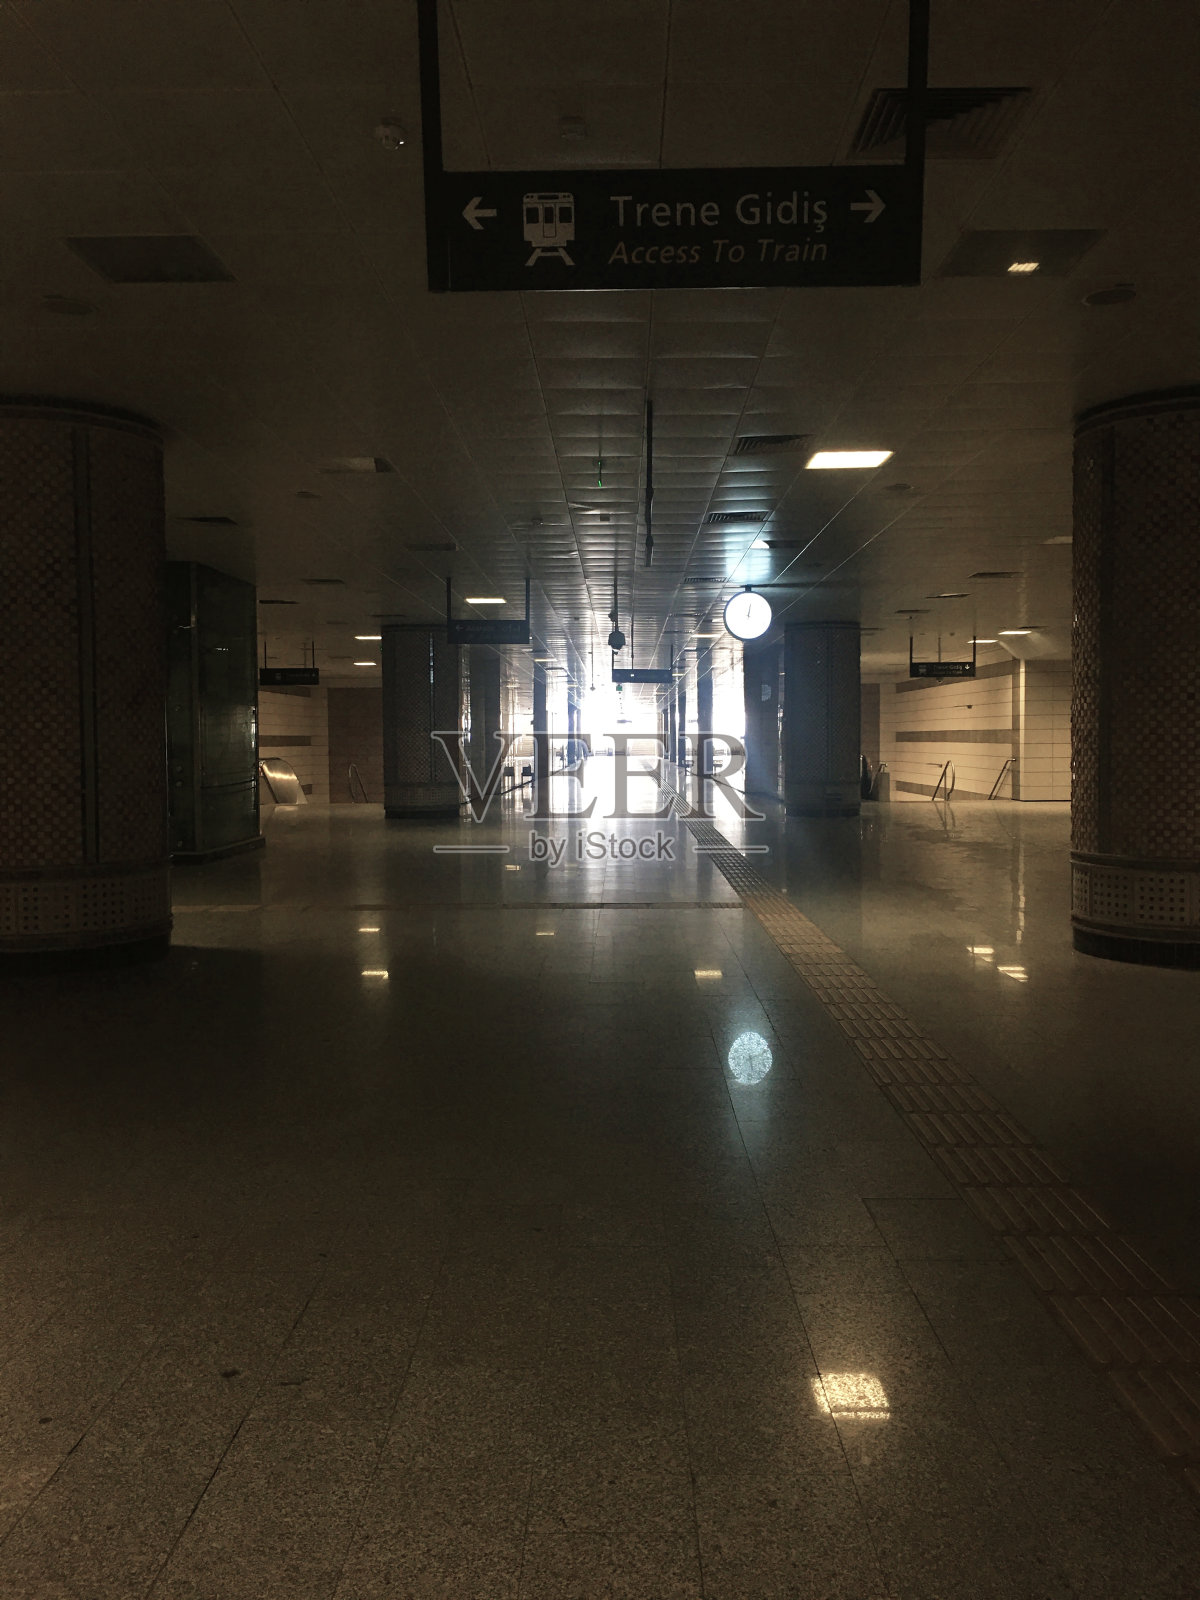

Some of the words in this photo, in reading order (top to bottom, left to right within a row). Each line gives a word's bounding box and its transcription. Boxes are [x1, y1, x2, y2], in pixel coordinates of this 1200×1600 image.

[609, 195, 721, 227] Trene
[735, 190, 829, 233] Gidiş
[607, 240, 702, 265] Access
[712, 239, 745, 263] To
[757, 236, 828, 262] Train
